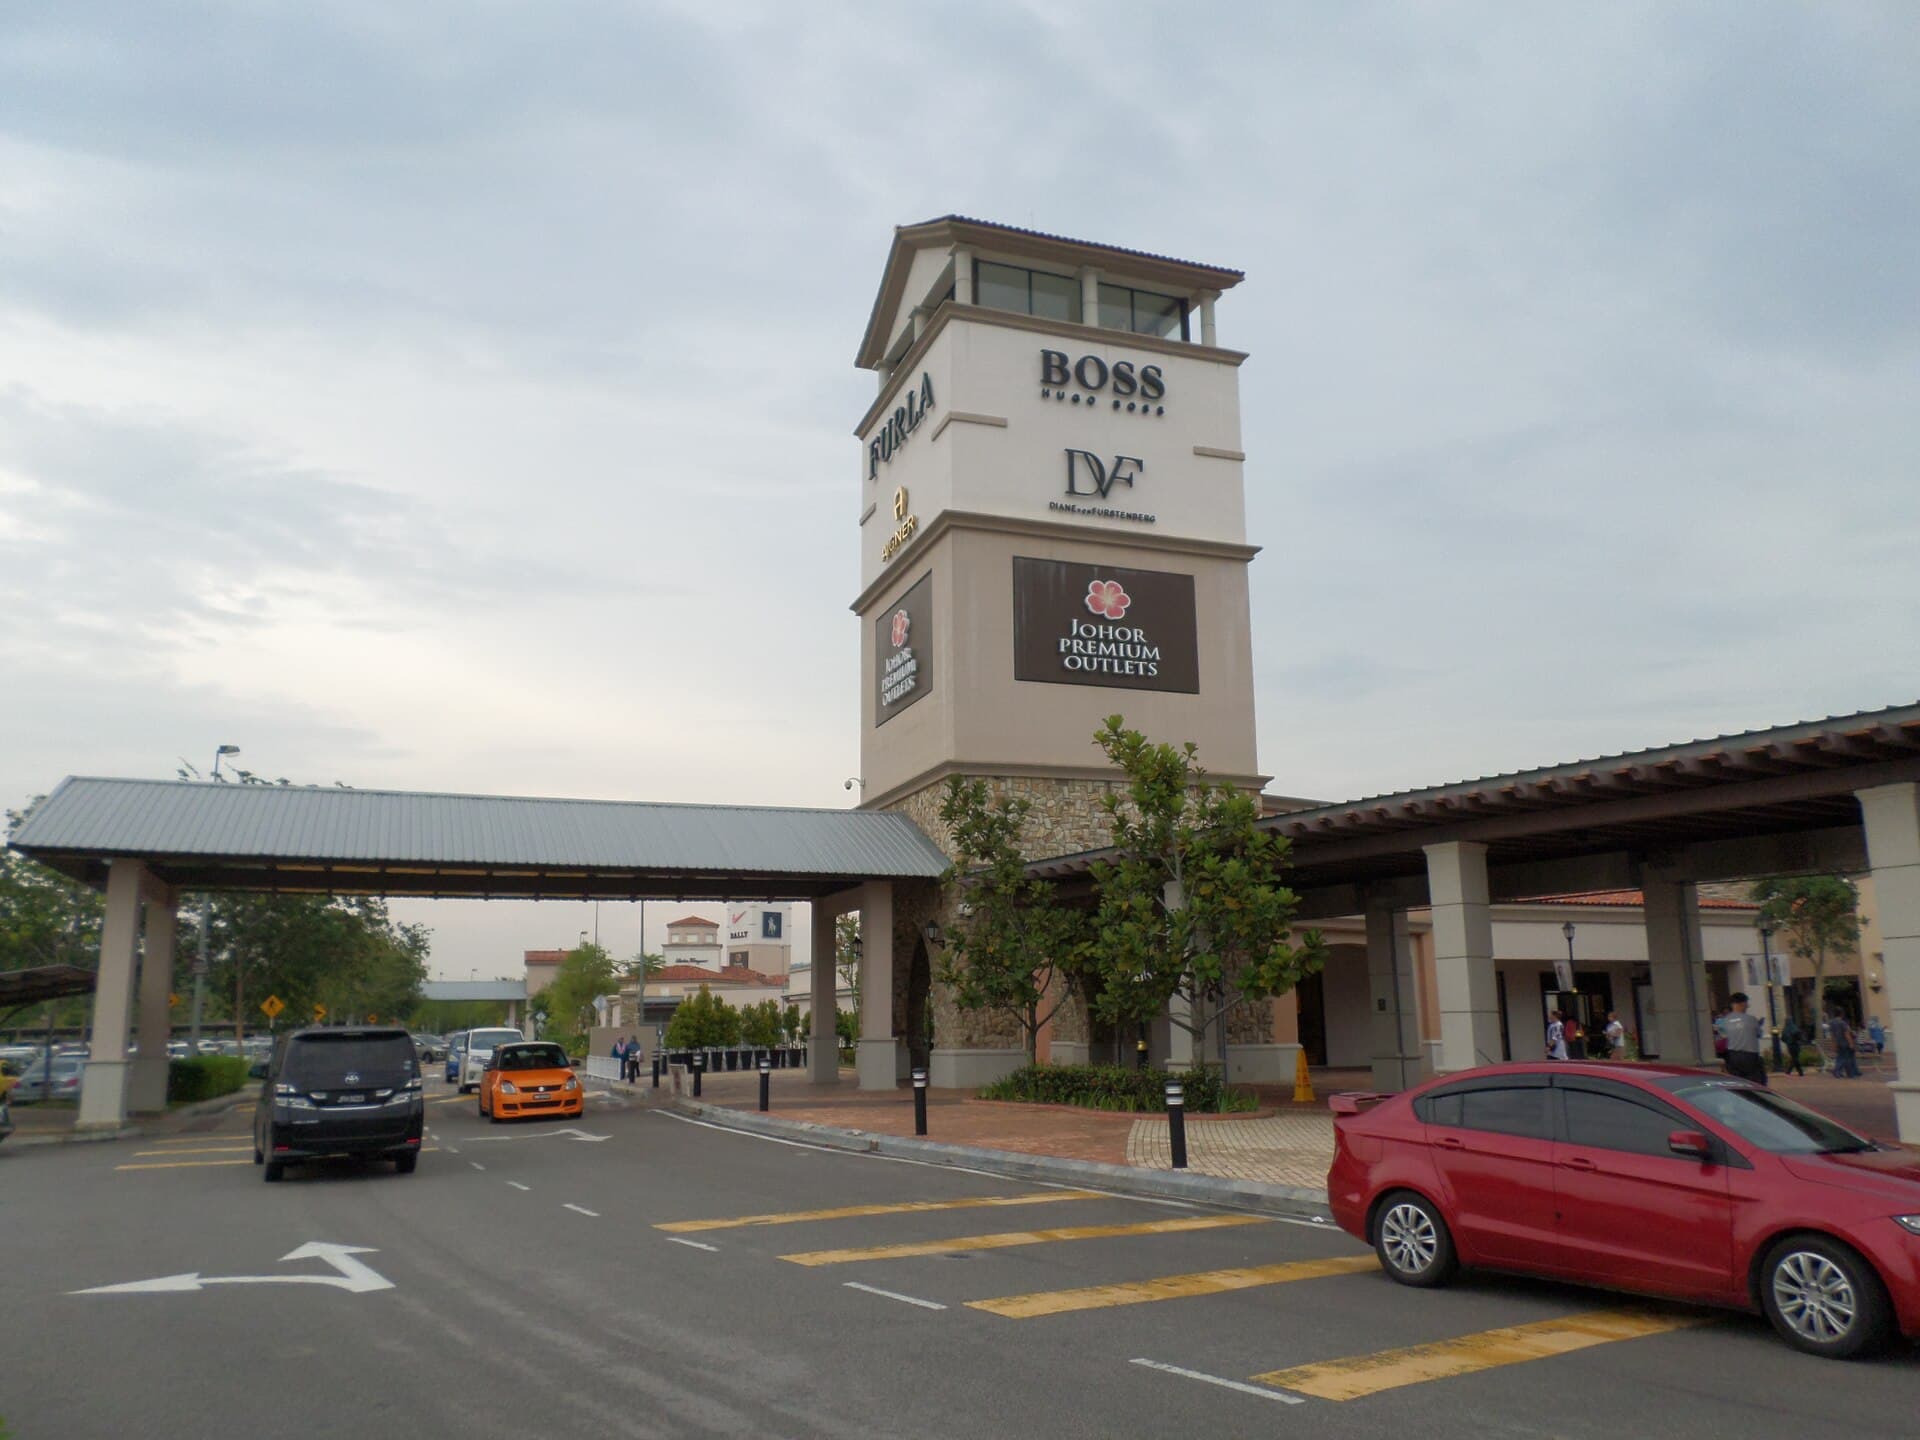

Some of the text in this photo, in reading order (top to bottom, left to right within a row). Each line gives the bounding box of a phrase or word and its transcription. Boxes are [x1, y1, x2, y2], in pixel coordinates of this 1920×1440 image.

[1040, 349, 1165, 400] BOSS
[1041, 387, 1096, 406] HUGO
[869, 371, 935, 481] FURLA
[1064, 448, 1143, 498] DVF
[1049, 501, 1077, 514] DIANE
[881, 514, 917, 562] AIGNER
[1071, 618, 1147, 644] JOHOR
[1059, 638, 1161, 661] PREMIUM
[1064, 655, 1158, 677] OUTLETS
